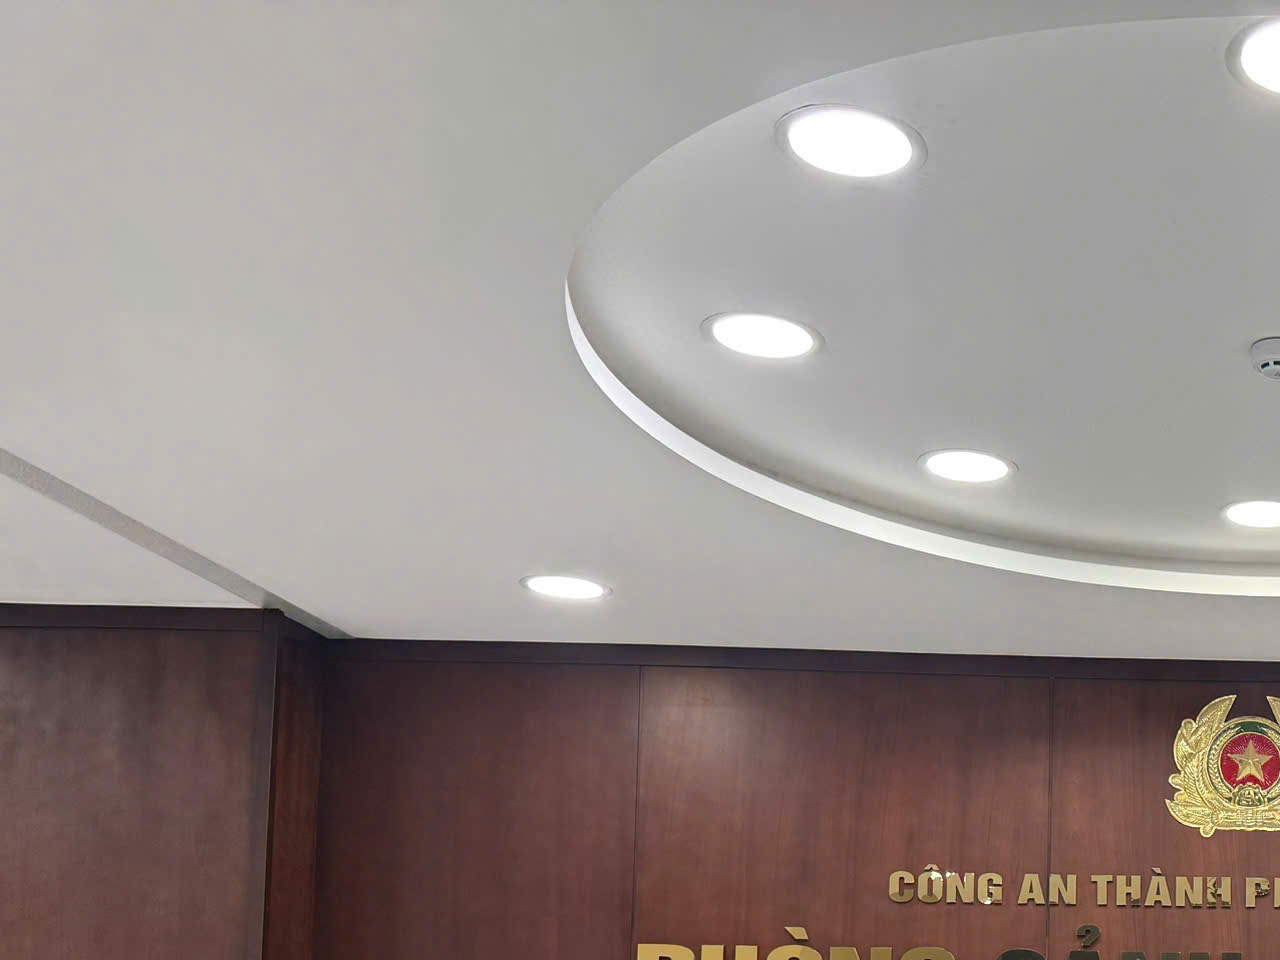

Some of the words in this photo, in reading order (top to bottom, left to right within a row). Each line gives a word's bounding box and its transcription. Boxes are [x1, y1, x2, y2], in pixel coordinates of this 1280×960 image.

[888, 864, 1003, 905] CÔNG
[1017, 873, 1078, 905] AN
[1091, 867, 1233, 909] THÀNH
